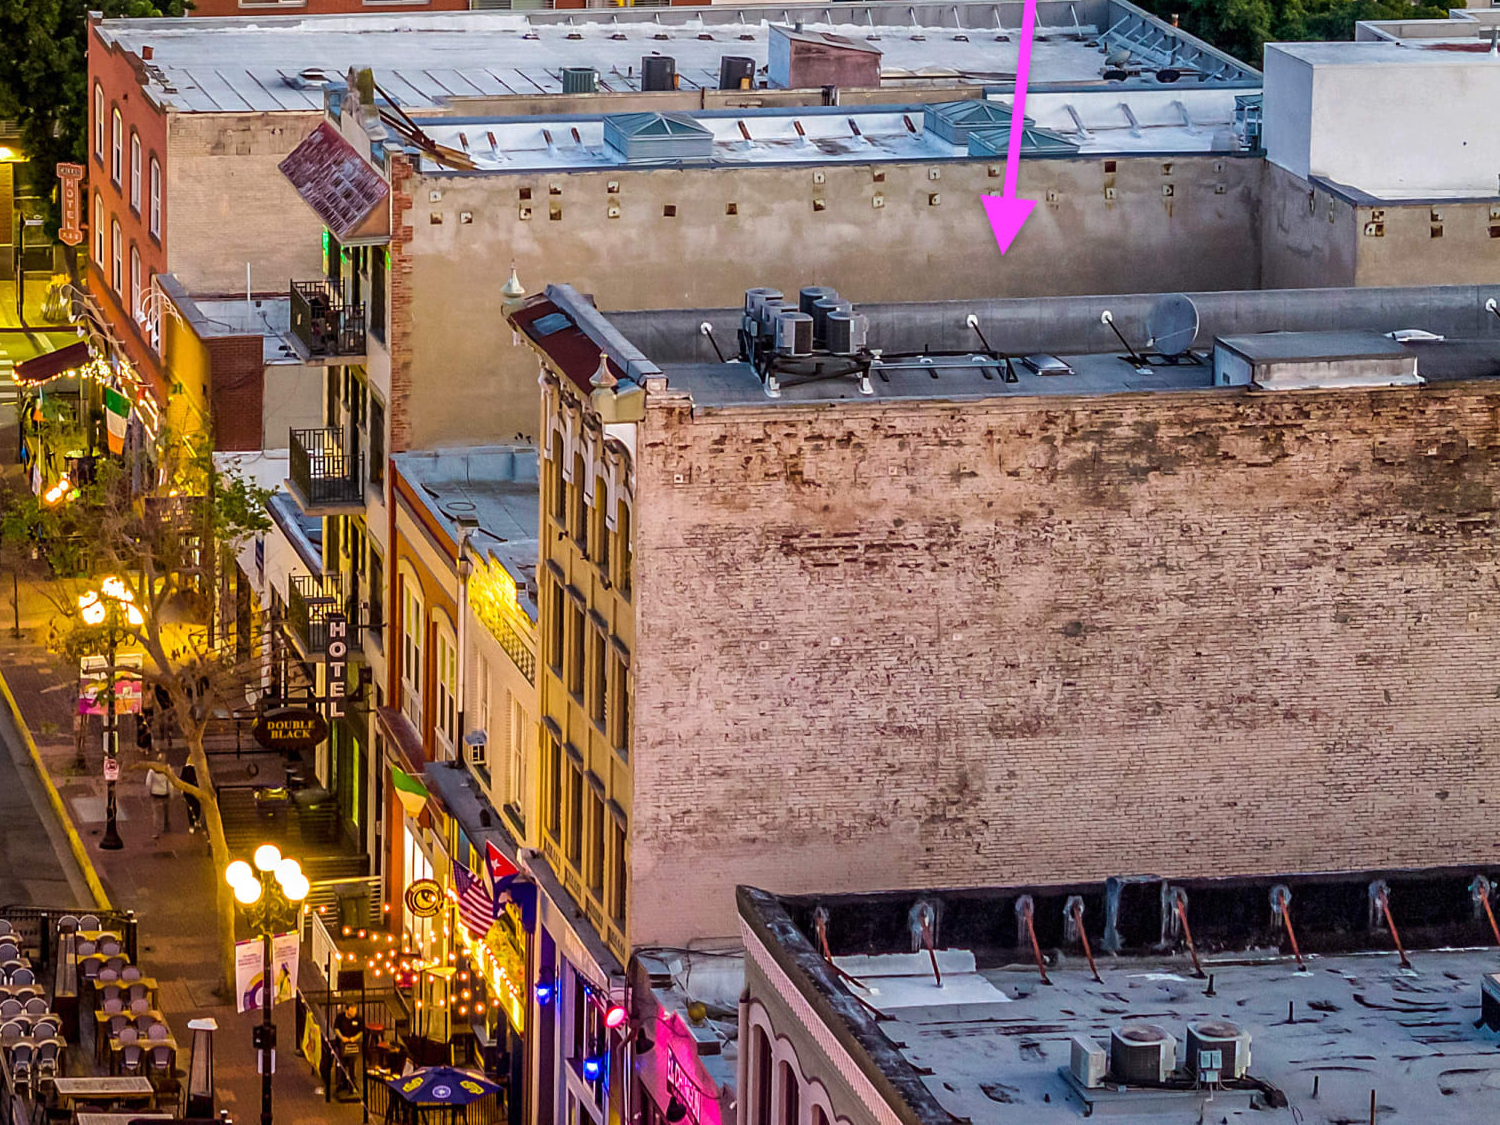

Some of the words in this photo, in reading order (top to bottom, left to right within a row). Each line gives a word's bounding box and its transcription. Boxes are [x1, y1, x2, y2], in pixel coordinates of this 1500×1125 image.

[65, 178, 75, 230] HOTEL
[328, 621, 347, 718] HOTEL
[267, 720, 316, 730] DOUBLE
[270, 729, 311, 740] BLACK
